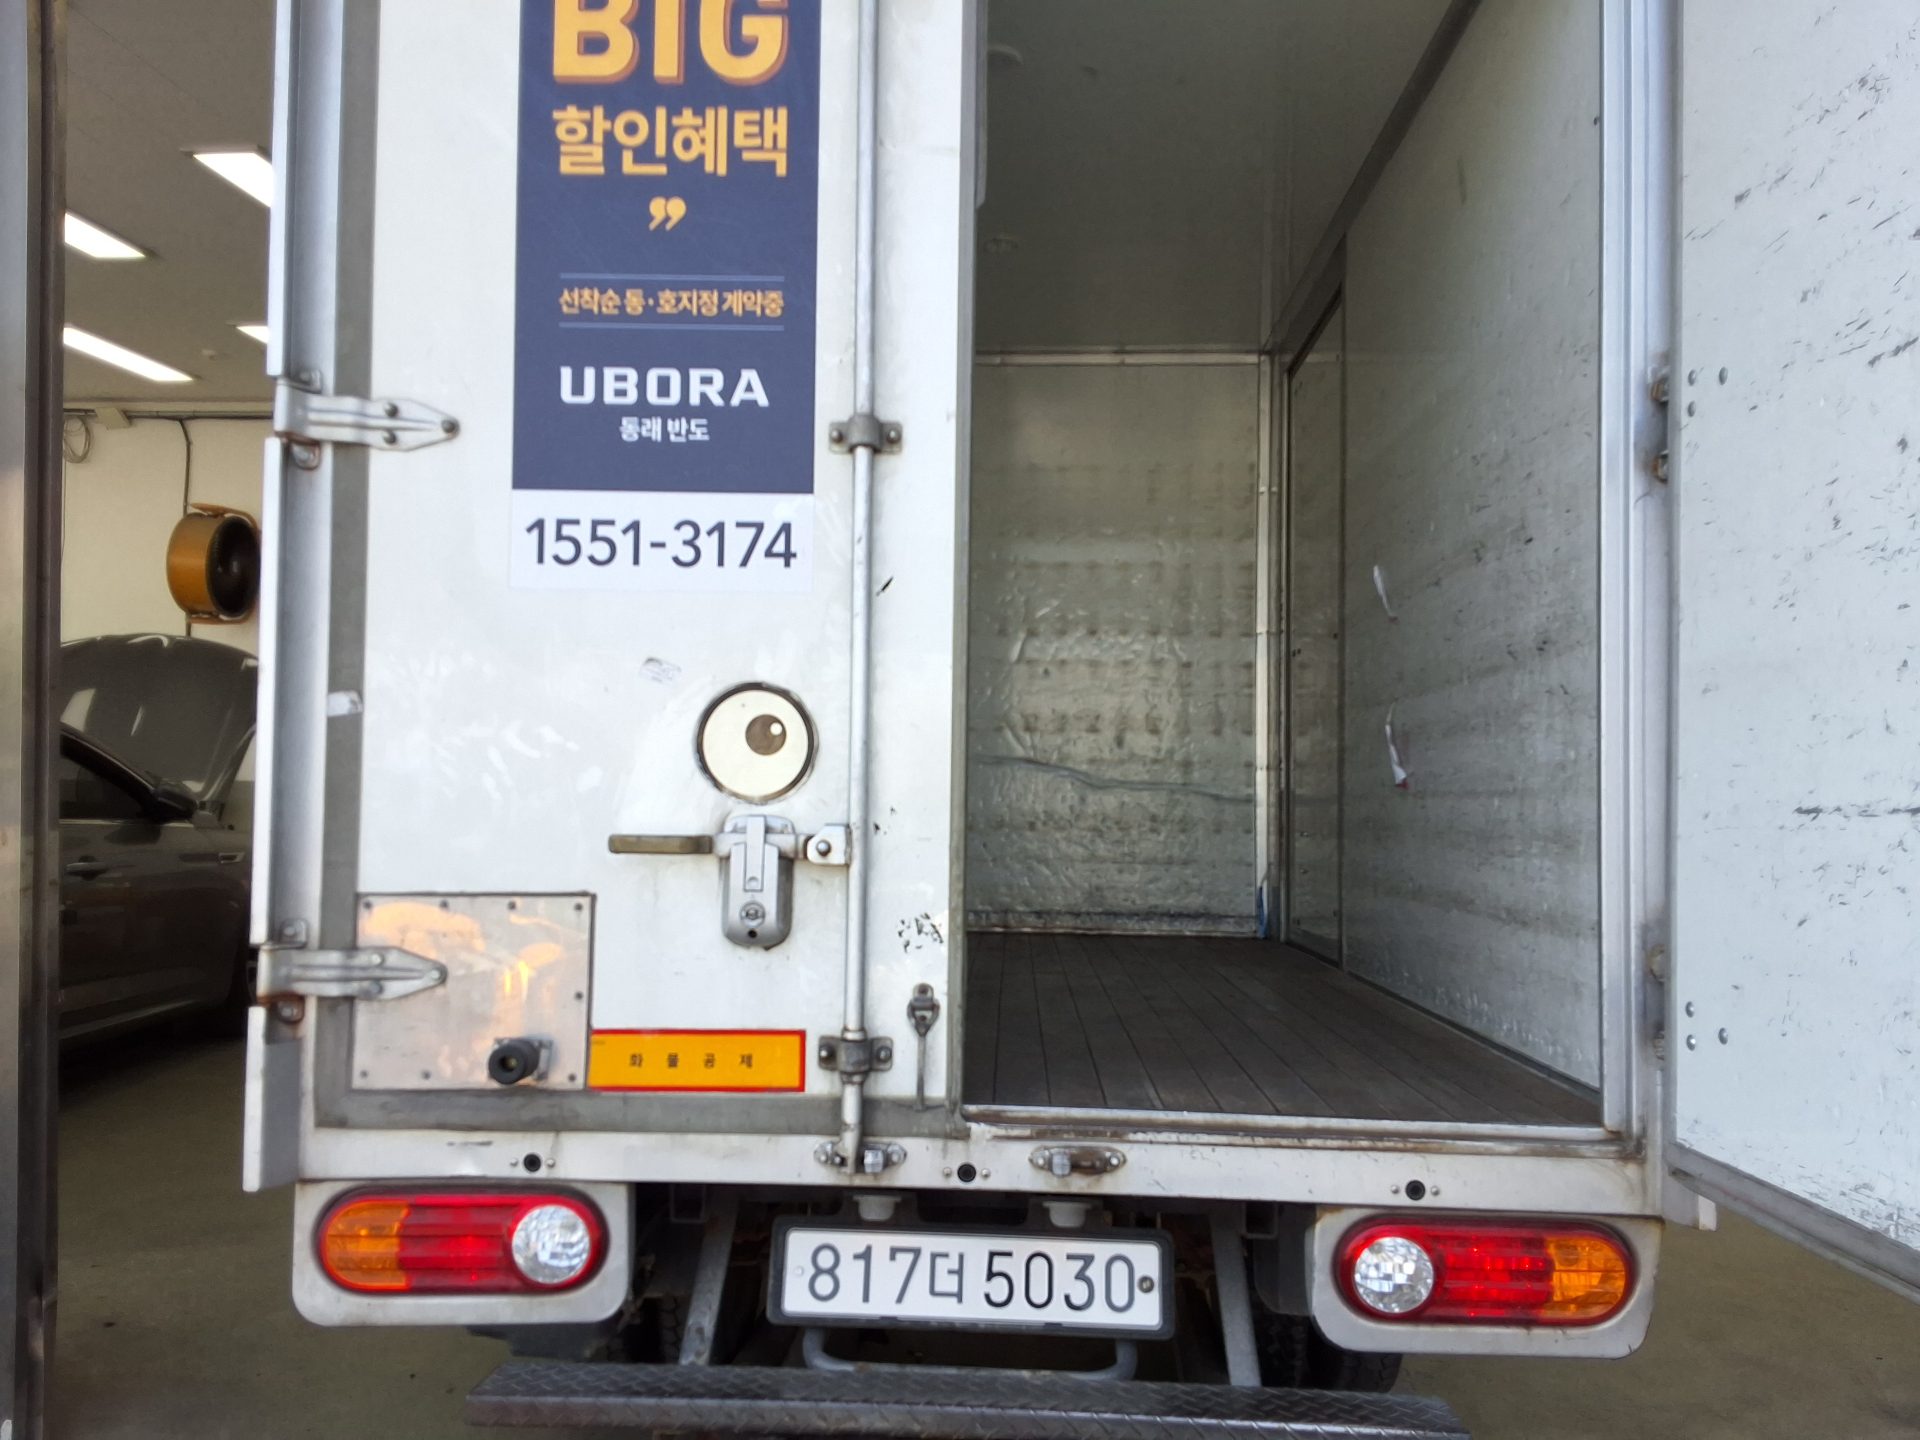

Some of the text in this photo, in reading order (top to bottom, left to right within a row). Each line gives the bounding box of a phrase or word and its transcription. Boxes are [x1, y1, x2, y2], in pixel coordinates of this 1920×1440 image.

[553, 0, 788, 85] BIG
[552, 105, 788, 177] 할인혜택
[560, 366, 770, 407] UBORA
[666, 417, 710, 443] 반도
[525, 518, 797, 568] 1551-3174
